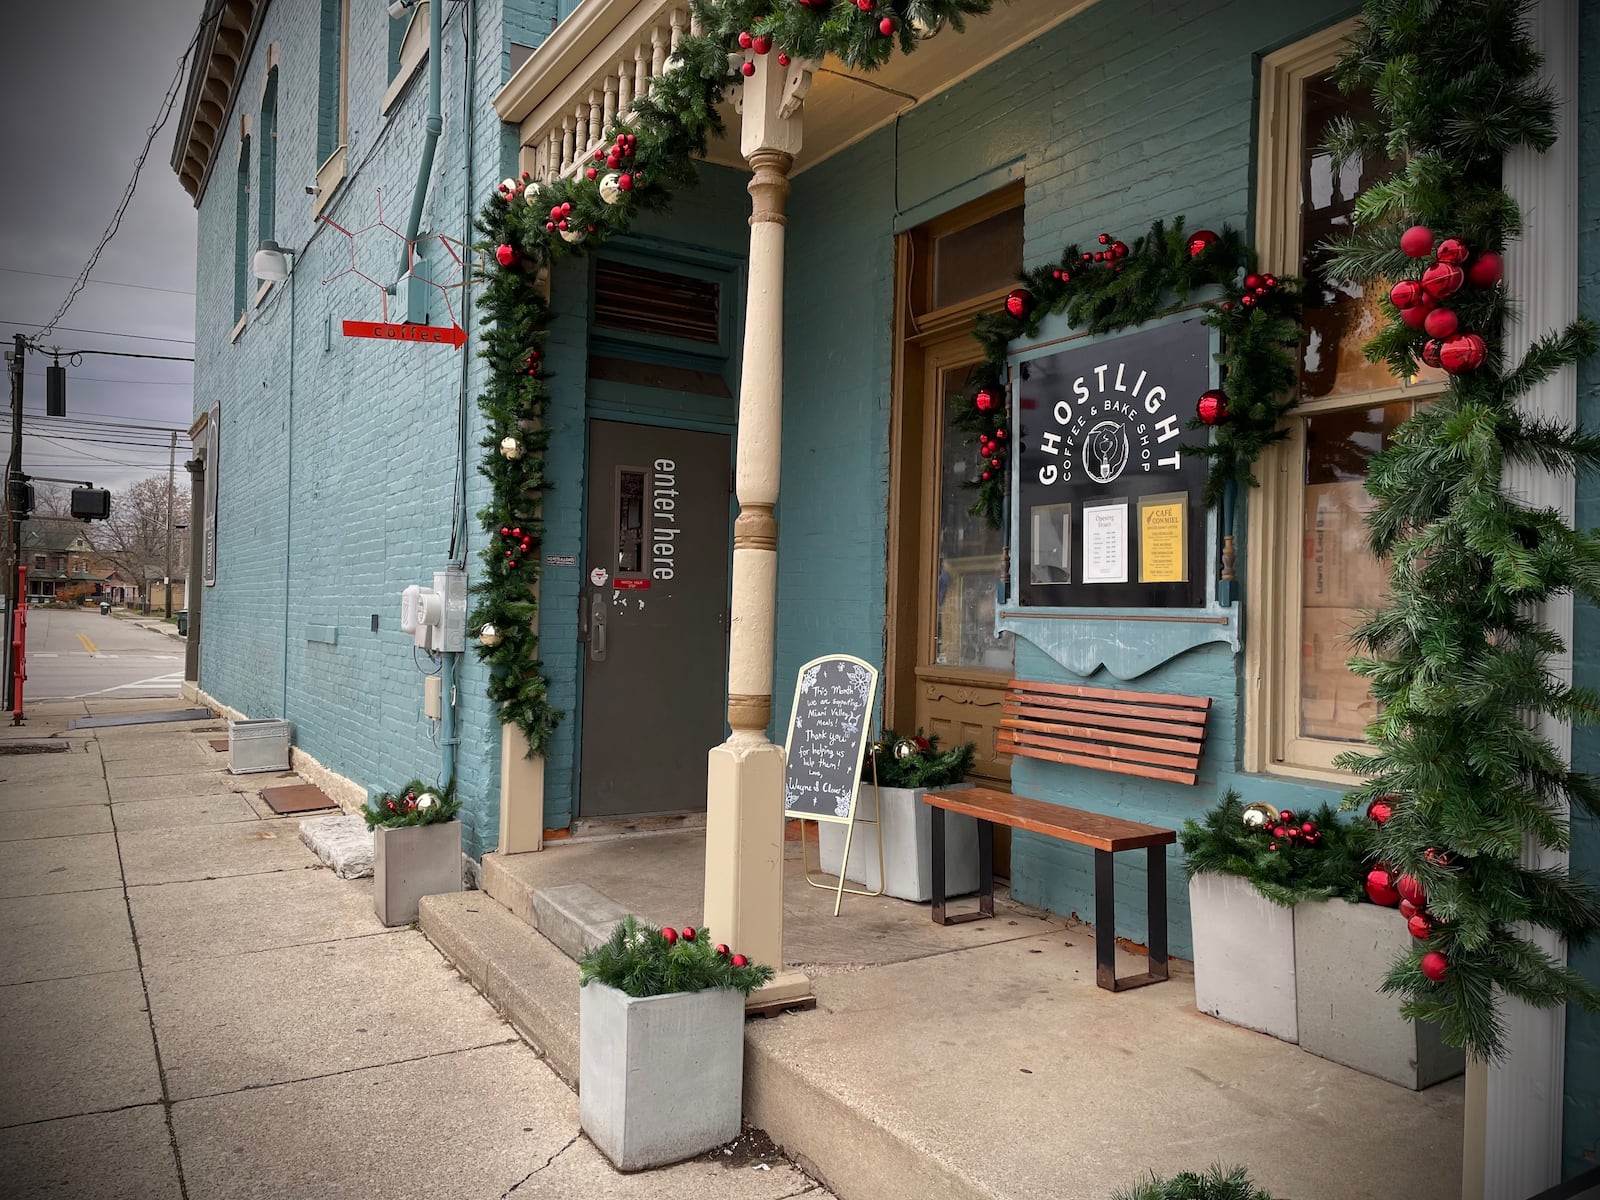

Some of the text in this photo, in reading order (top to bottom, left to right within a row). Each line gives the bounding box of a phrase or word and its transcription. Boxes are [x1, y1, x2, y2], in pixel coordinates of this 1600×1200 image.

[374, 327, 442, 341] coffee
[1039, 362, 1181, 486] GHOSTLIGHT
[1063, 399, 1151, 482] COFFEE & BAKE SHOP
[653, 458, 681, 580] enter here
[1155, 507, 1173, 517] CAFÉ
[812, 685, 854, 697] This Month
[830, 708, 850, 720] Valley
[805, 730, 847, 746] Thank you
[798, 744, 845, 758] for helping us
[803, 757, 815, 768] help
[789, 777, 812, 795] Wayne
